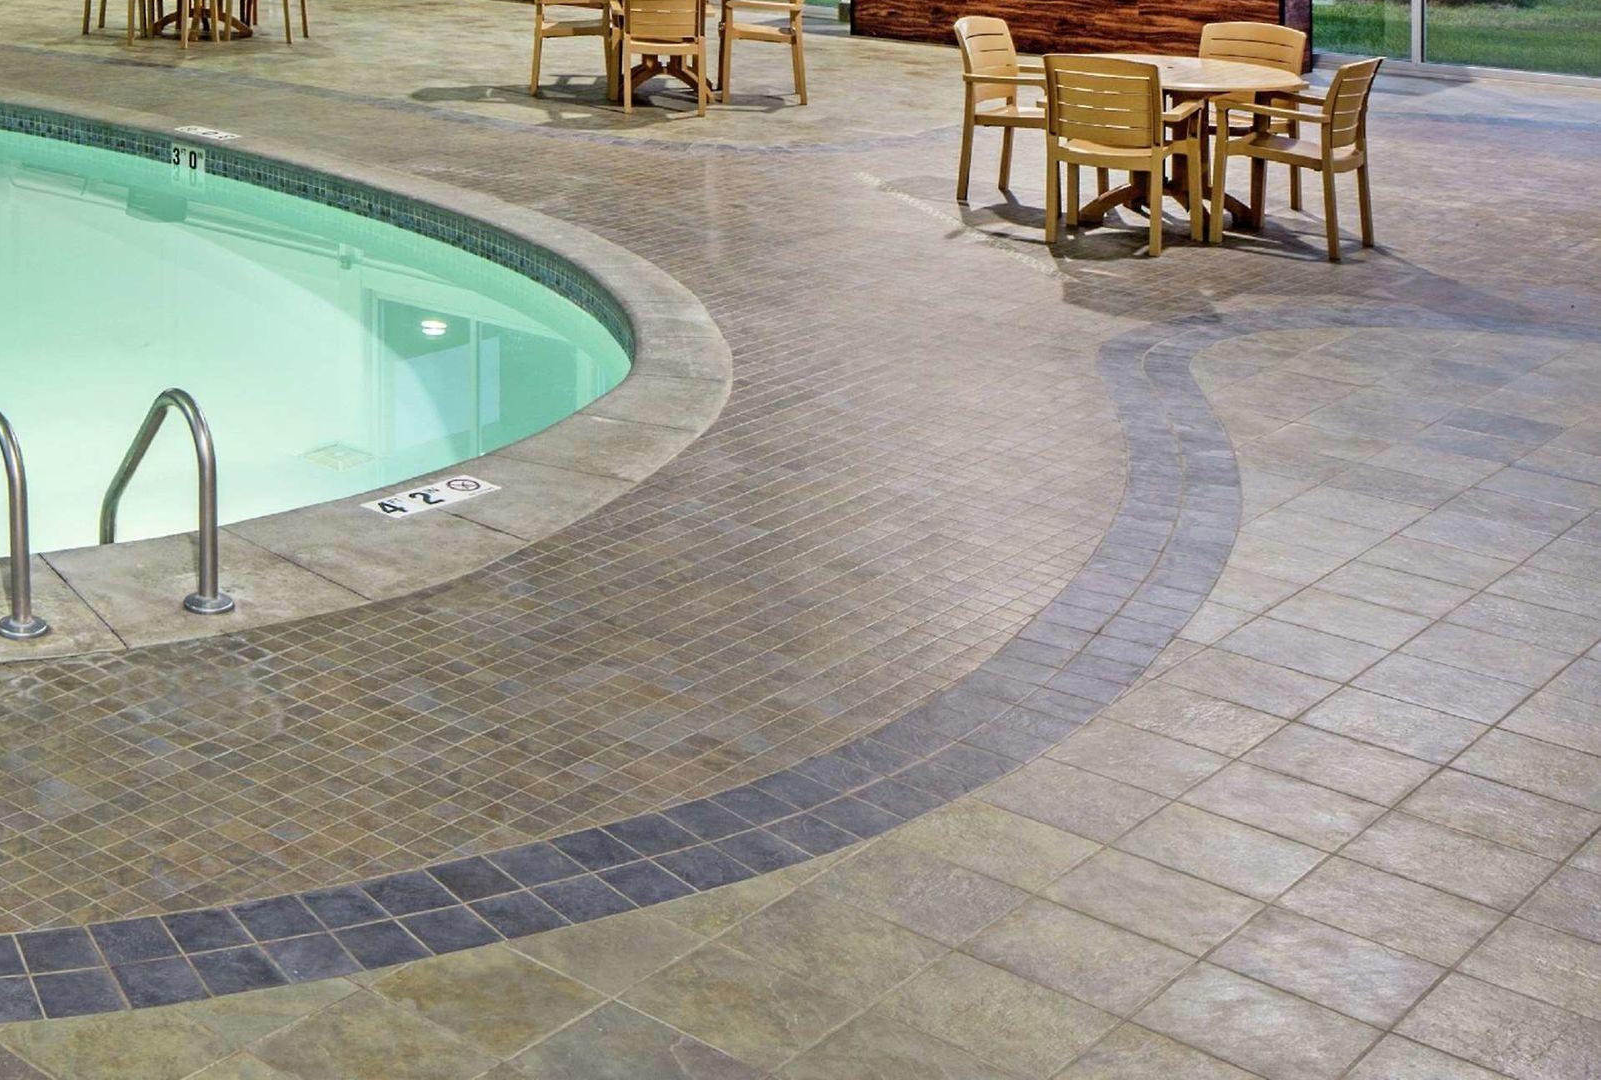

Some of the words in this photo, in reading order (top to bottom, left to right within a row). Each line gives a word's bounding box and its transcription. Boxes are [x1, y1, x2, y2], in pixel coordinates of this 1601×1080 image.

[173, 147, 180, 165] 3
[189, 150, 197, 169] 0
[378, 501, 408, 514] 4
[408, 492, 445, 505] 2
